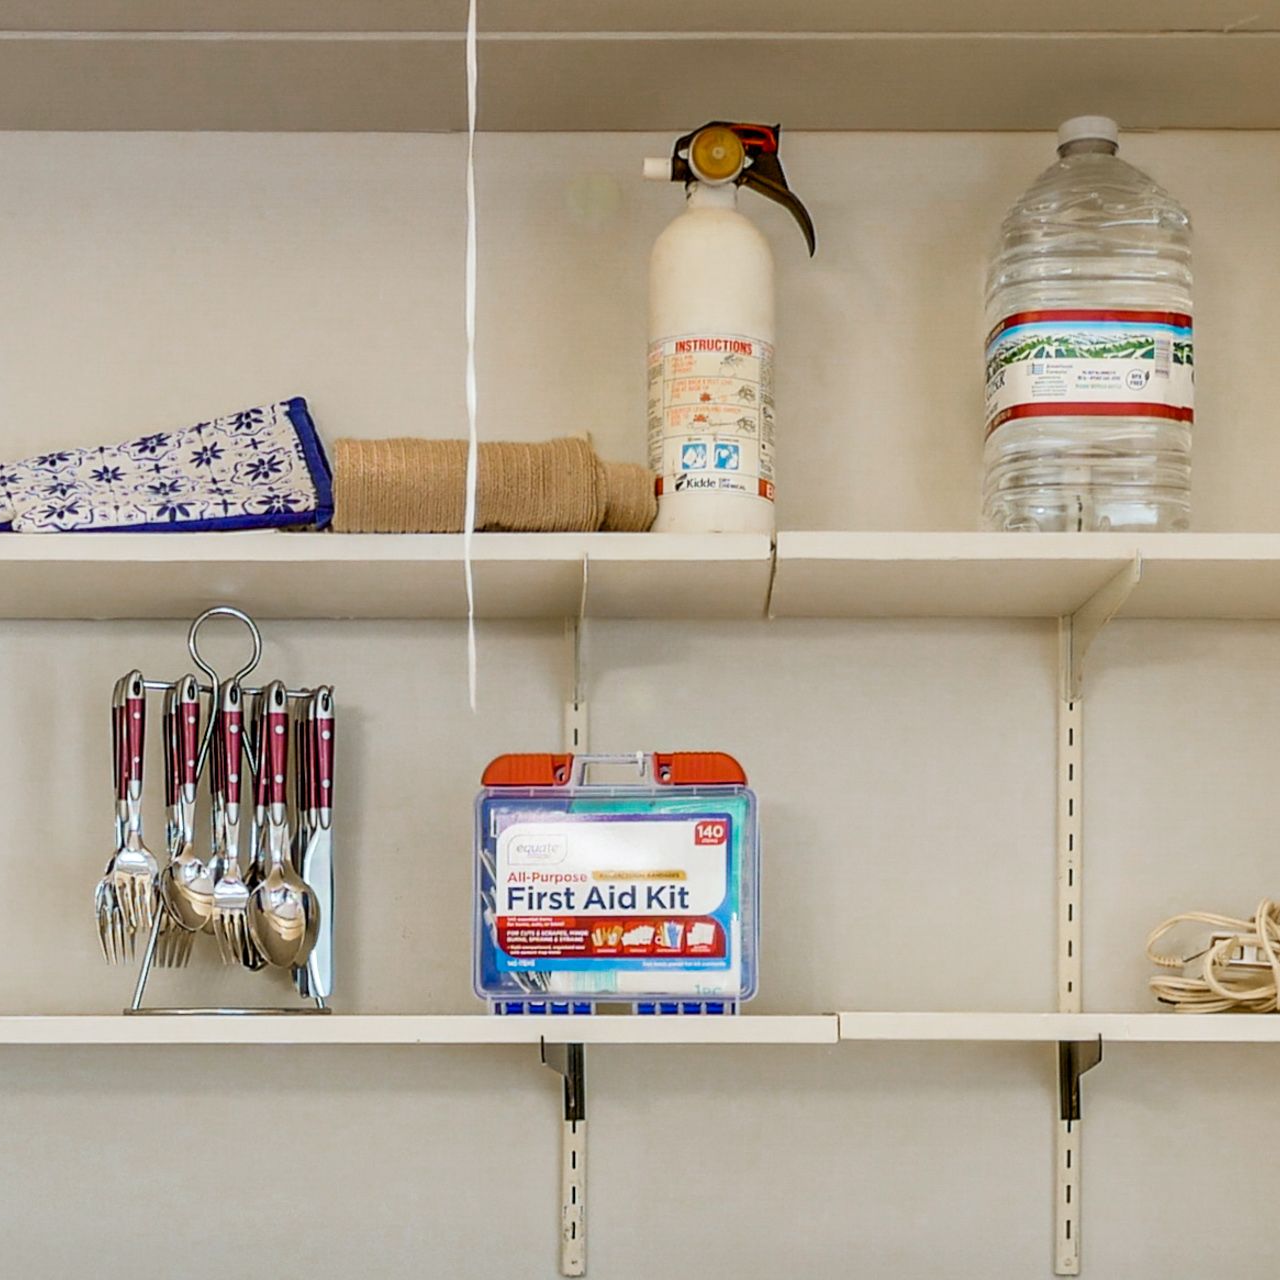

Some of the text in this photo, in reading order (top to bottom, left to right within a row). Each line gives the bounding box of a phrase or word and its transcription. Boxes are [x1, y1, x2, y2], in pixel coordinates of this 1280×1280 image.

[675, 338, 753, 356] INSTRUCTIONS
[686, 478, 716, 489] Kidde
[696, 825, 724, 838] 140
[507, 872, 588, 884] All-Purpose
[507, 885, 690, 911] First Aid Kit
